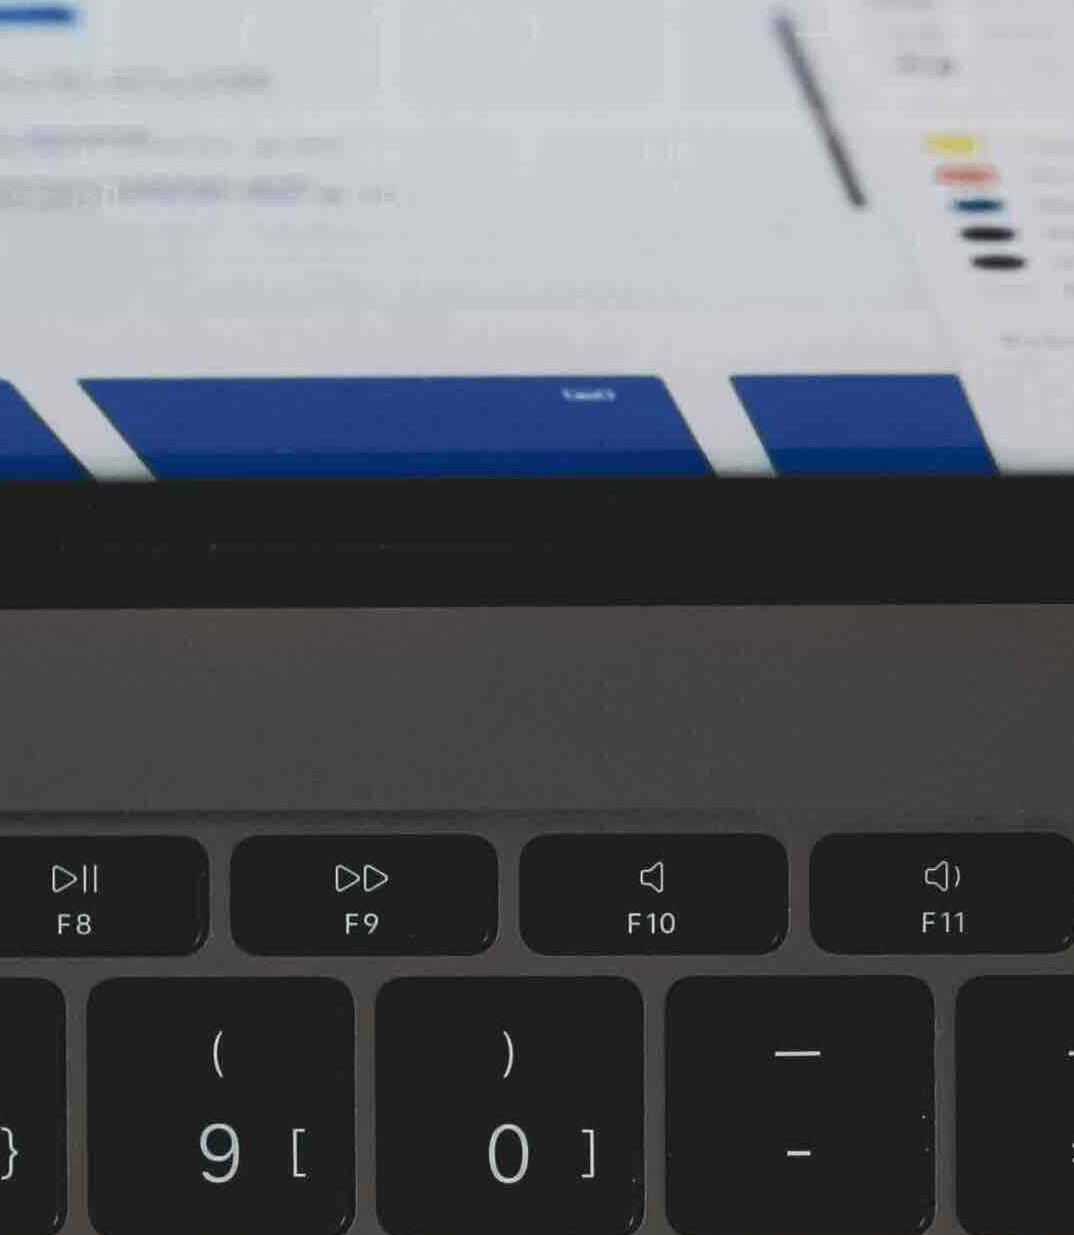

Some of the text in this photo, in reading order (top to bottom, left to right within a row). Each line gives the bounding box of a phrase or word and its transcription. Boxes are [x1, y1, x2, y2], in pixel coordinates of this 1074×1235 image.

[58, 914, 91, 935] F8
[346, 913, 379, 935] F9
[628, 913, 675, 935] F10
[922, 912, 963, 934] F11
[212, 1031, 224, 1078] (
[503, 1031, 514, 1078] )
[200, 1123, 306, 1184] 9 [
[581, 1129, 595, 1179] ]
